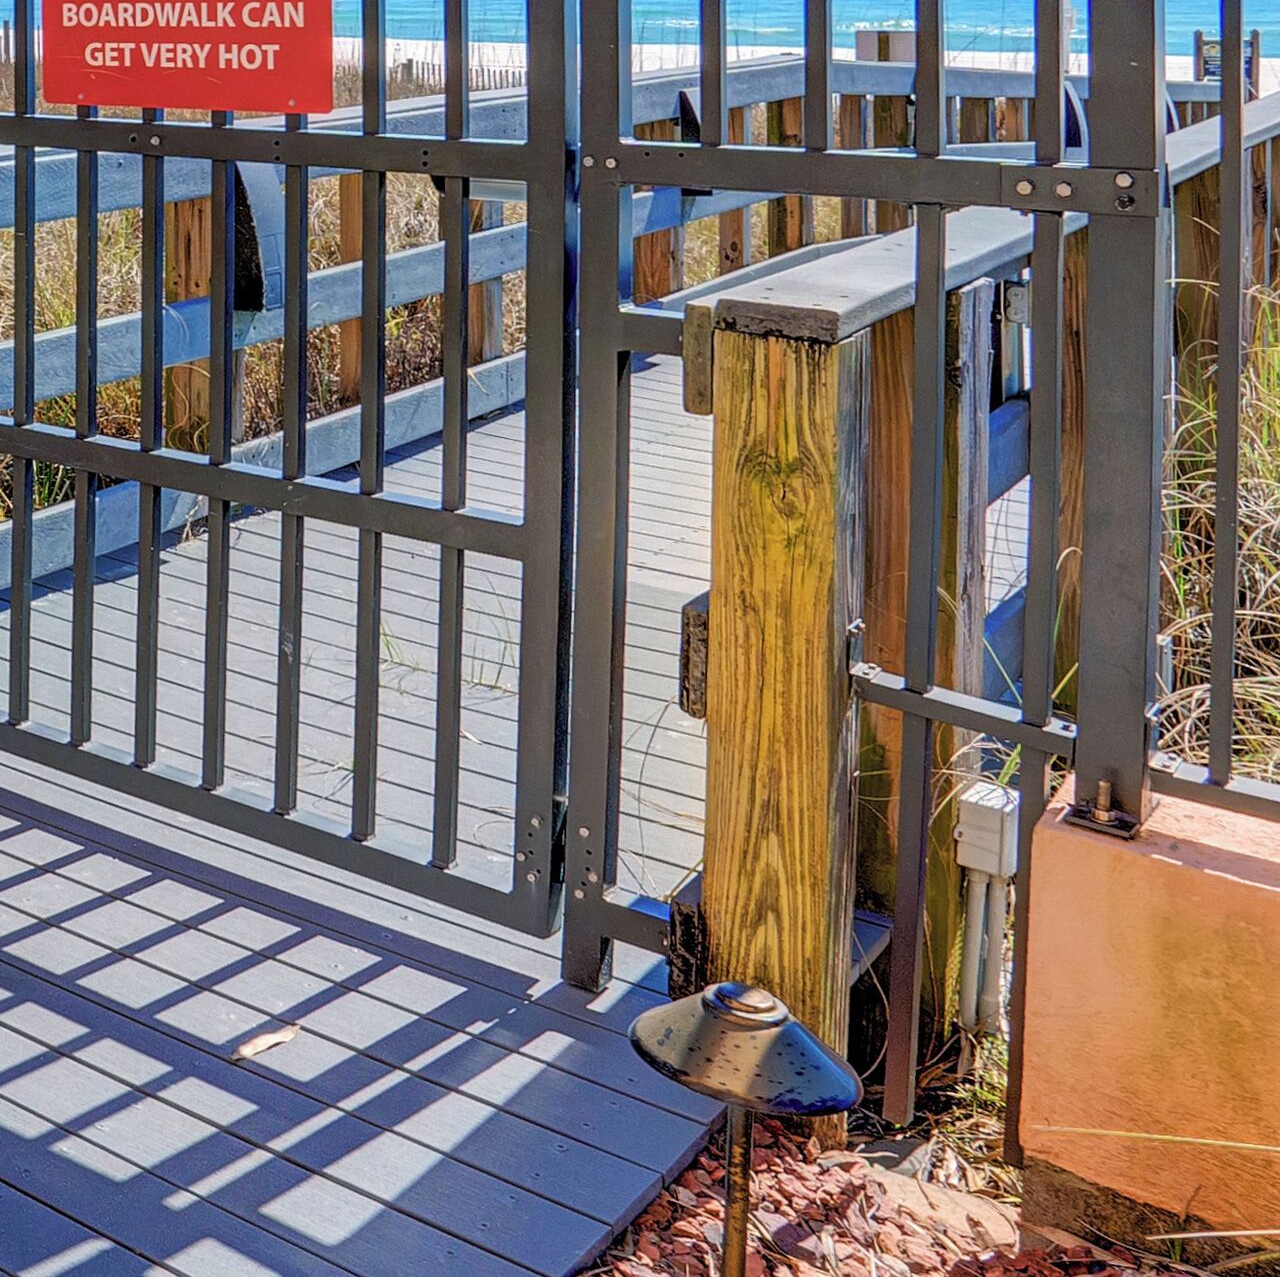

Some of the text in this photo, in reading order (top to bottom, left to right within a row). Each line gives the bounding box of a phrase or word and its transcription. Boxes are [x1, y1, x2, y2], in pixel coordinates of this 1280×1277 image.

[62, 1, 305, 28] BOARDWALK CAN
[84, 43, 280, 70] GET VERY HOT
